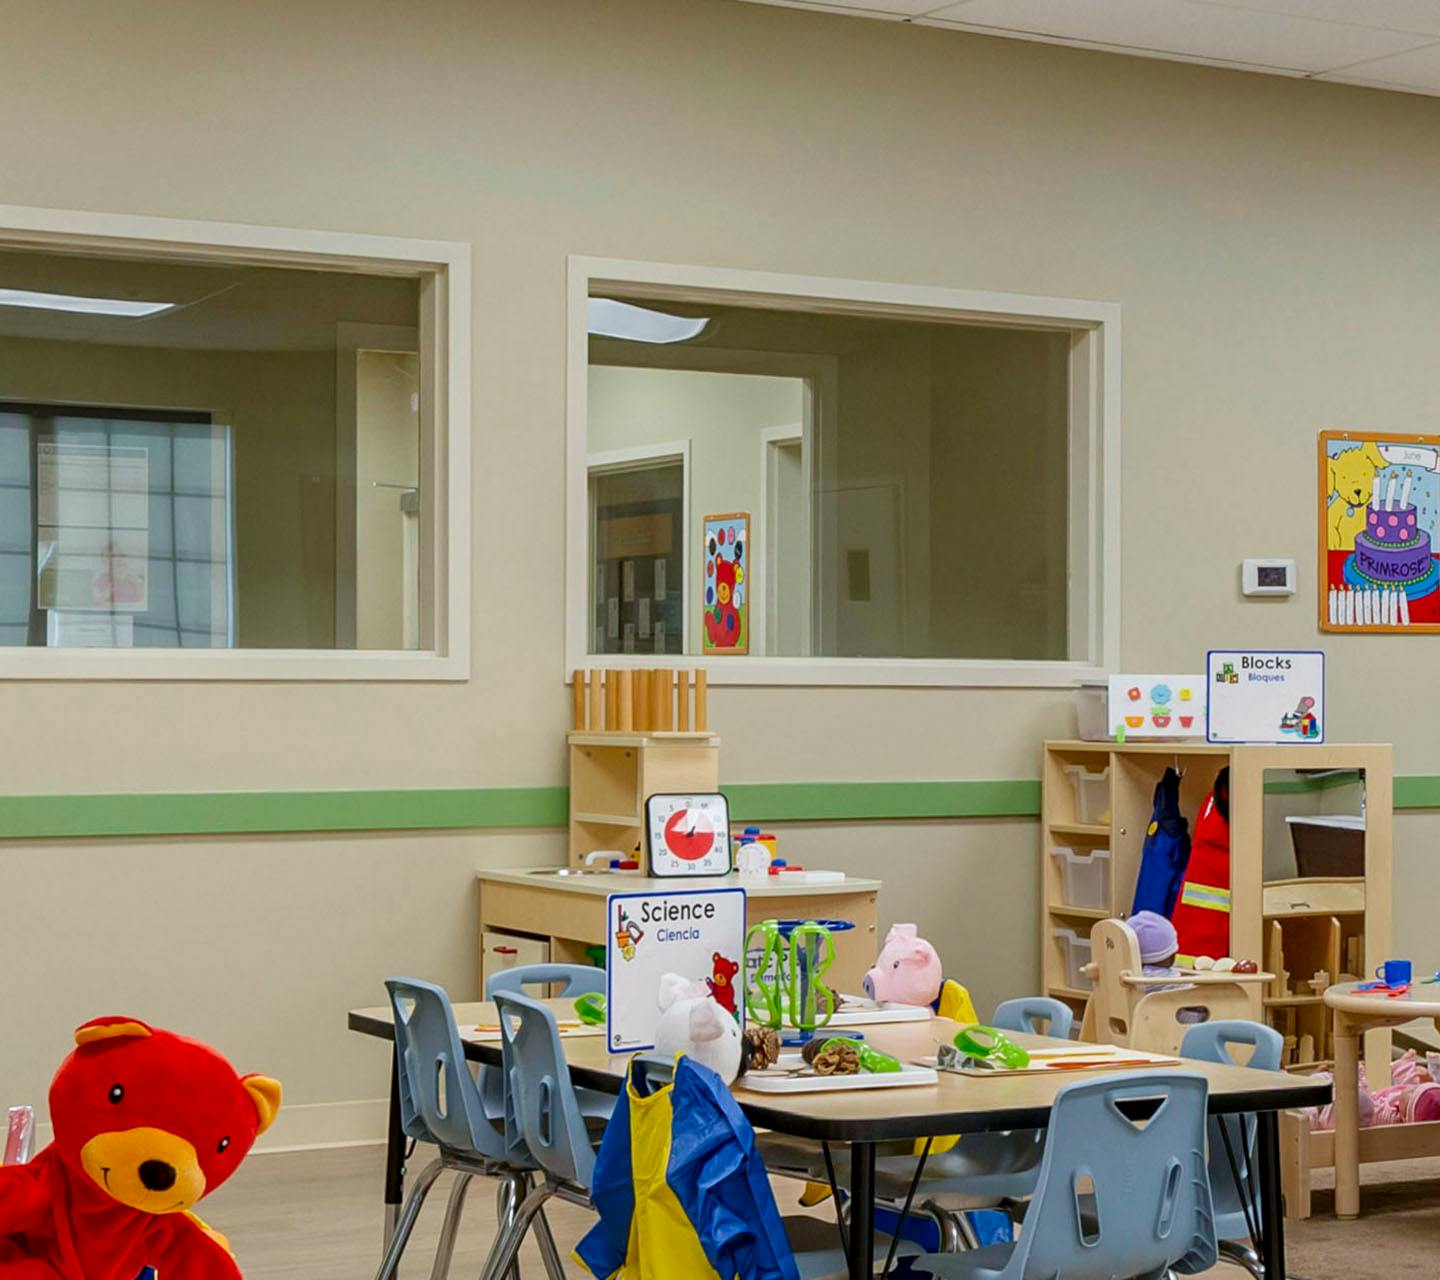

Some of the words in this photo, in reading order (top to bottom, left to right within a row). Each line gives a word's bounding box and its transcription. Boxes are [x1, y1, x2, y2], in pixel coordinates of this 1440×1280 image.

[1241, 656, 1292, 670] Blocks
[1248, 673, 1285, 683] Bloques
[640, 900, 716, 923] Science
[656, 926, 700, 942] Ciencia
